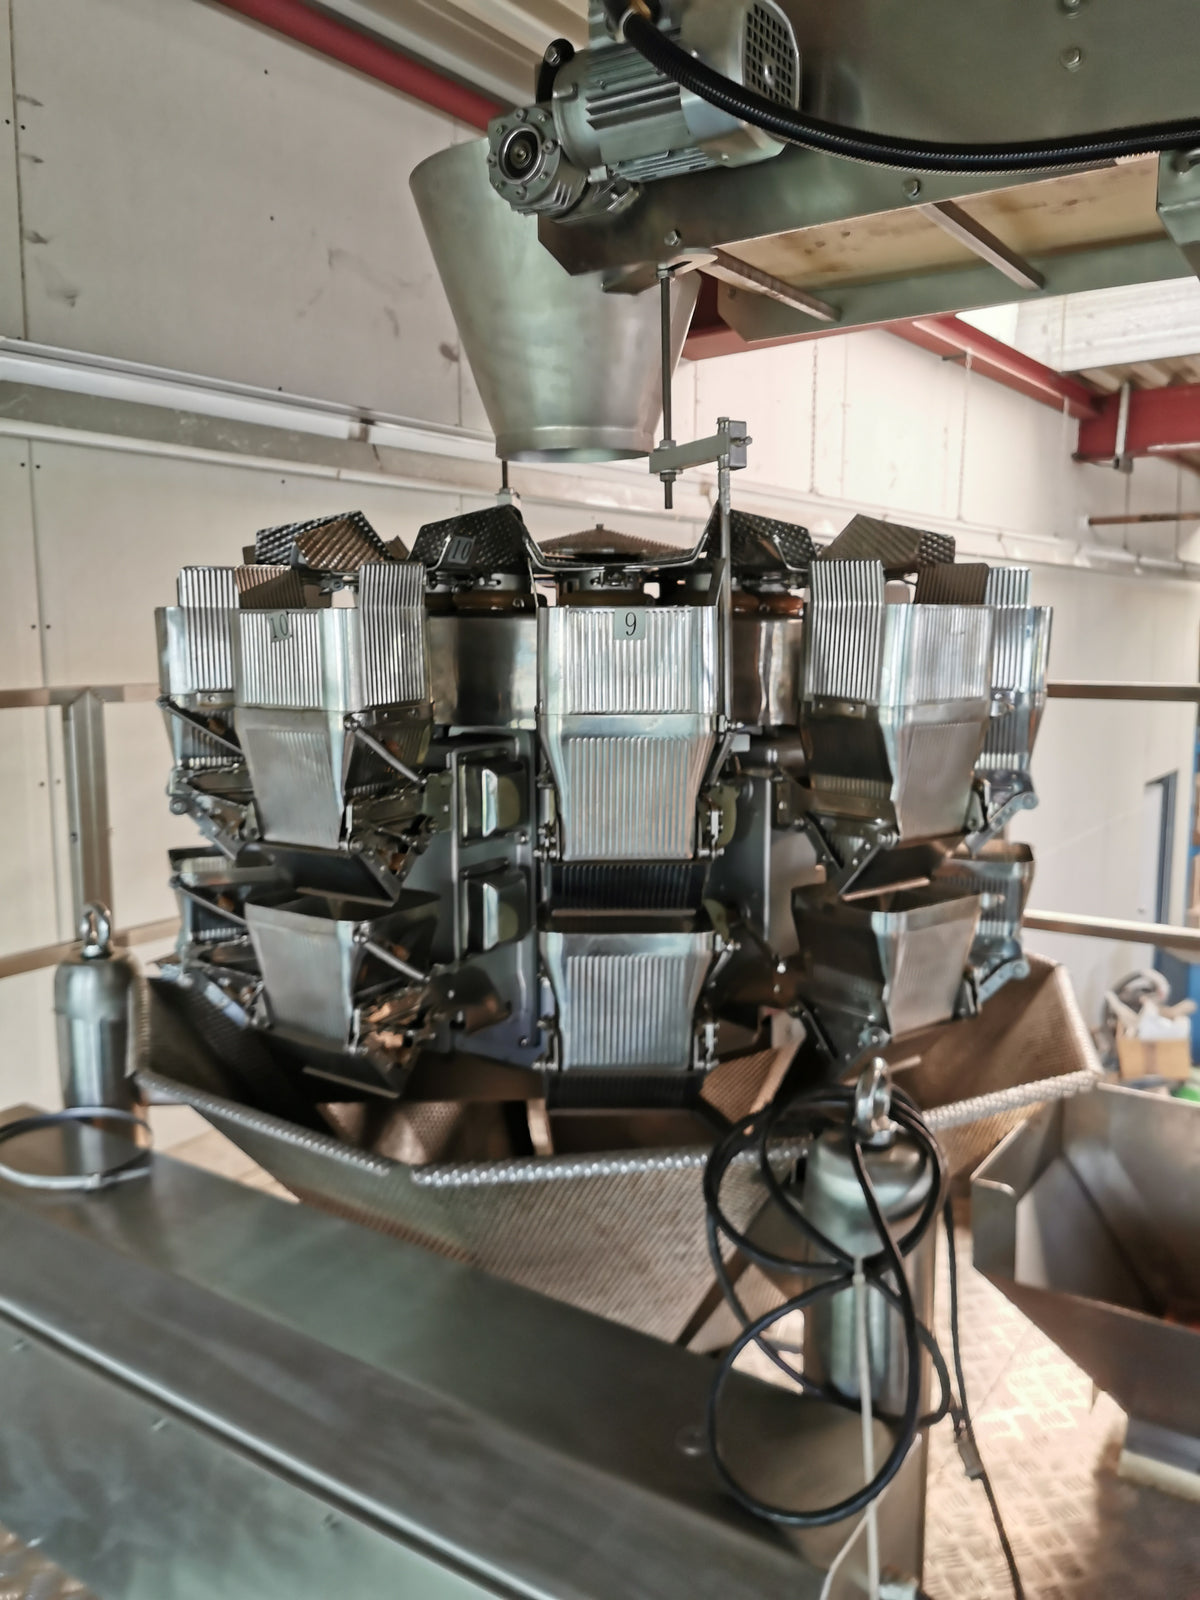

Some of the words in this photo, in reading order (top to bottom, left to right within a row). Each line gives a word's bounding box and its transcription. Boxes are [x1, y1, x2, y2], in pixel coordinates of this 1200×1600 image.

[452, 539, 472, 561] 10
[270, 613, 289, 639] 10
[625, 611, 637, 636] 9
